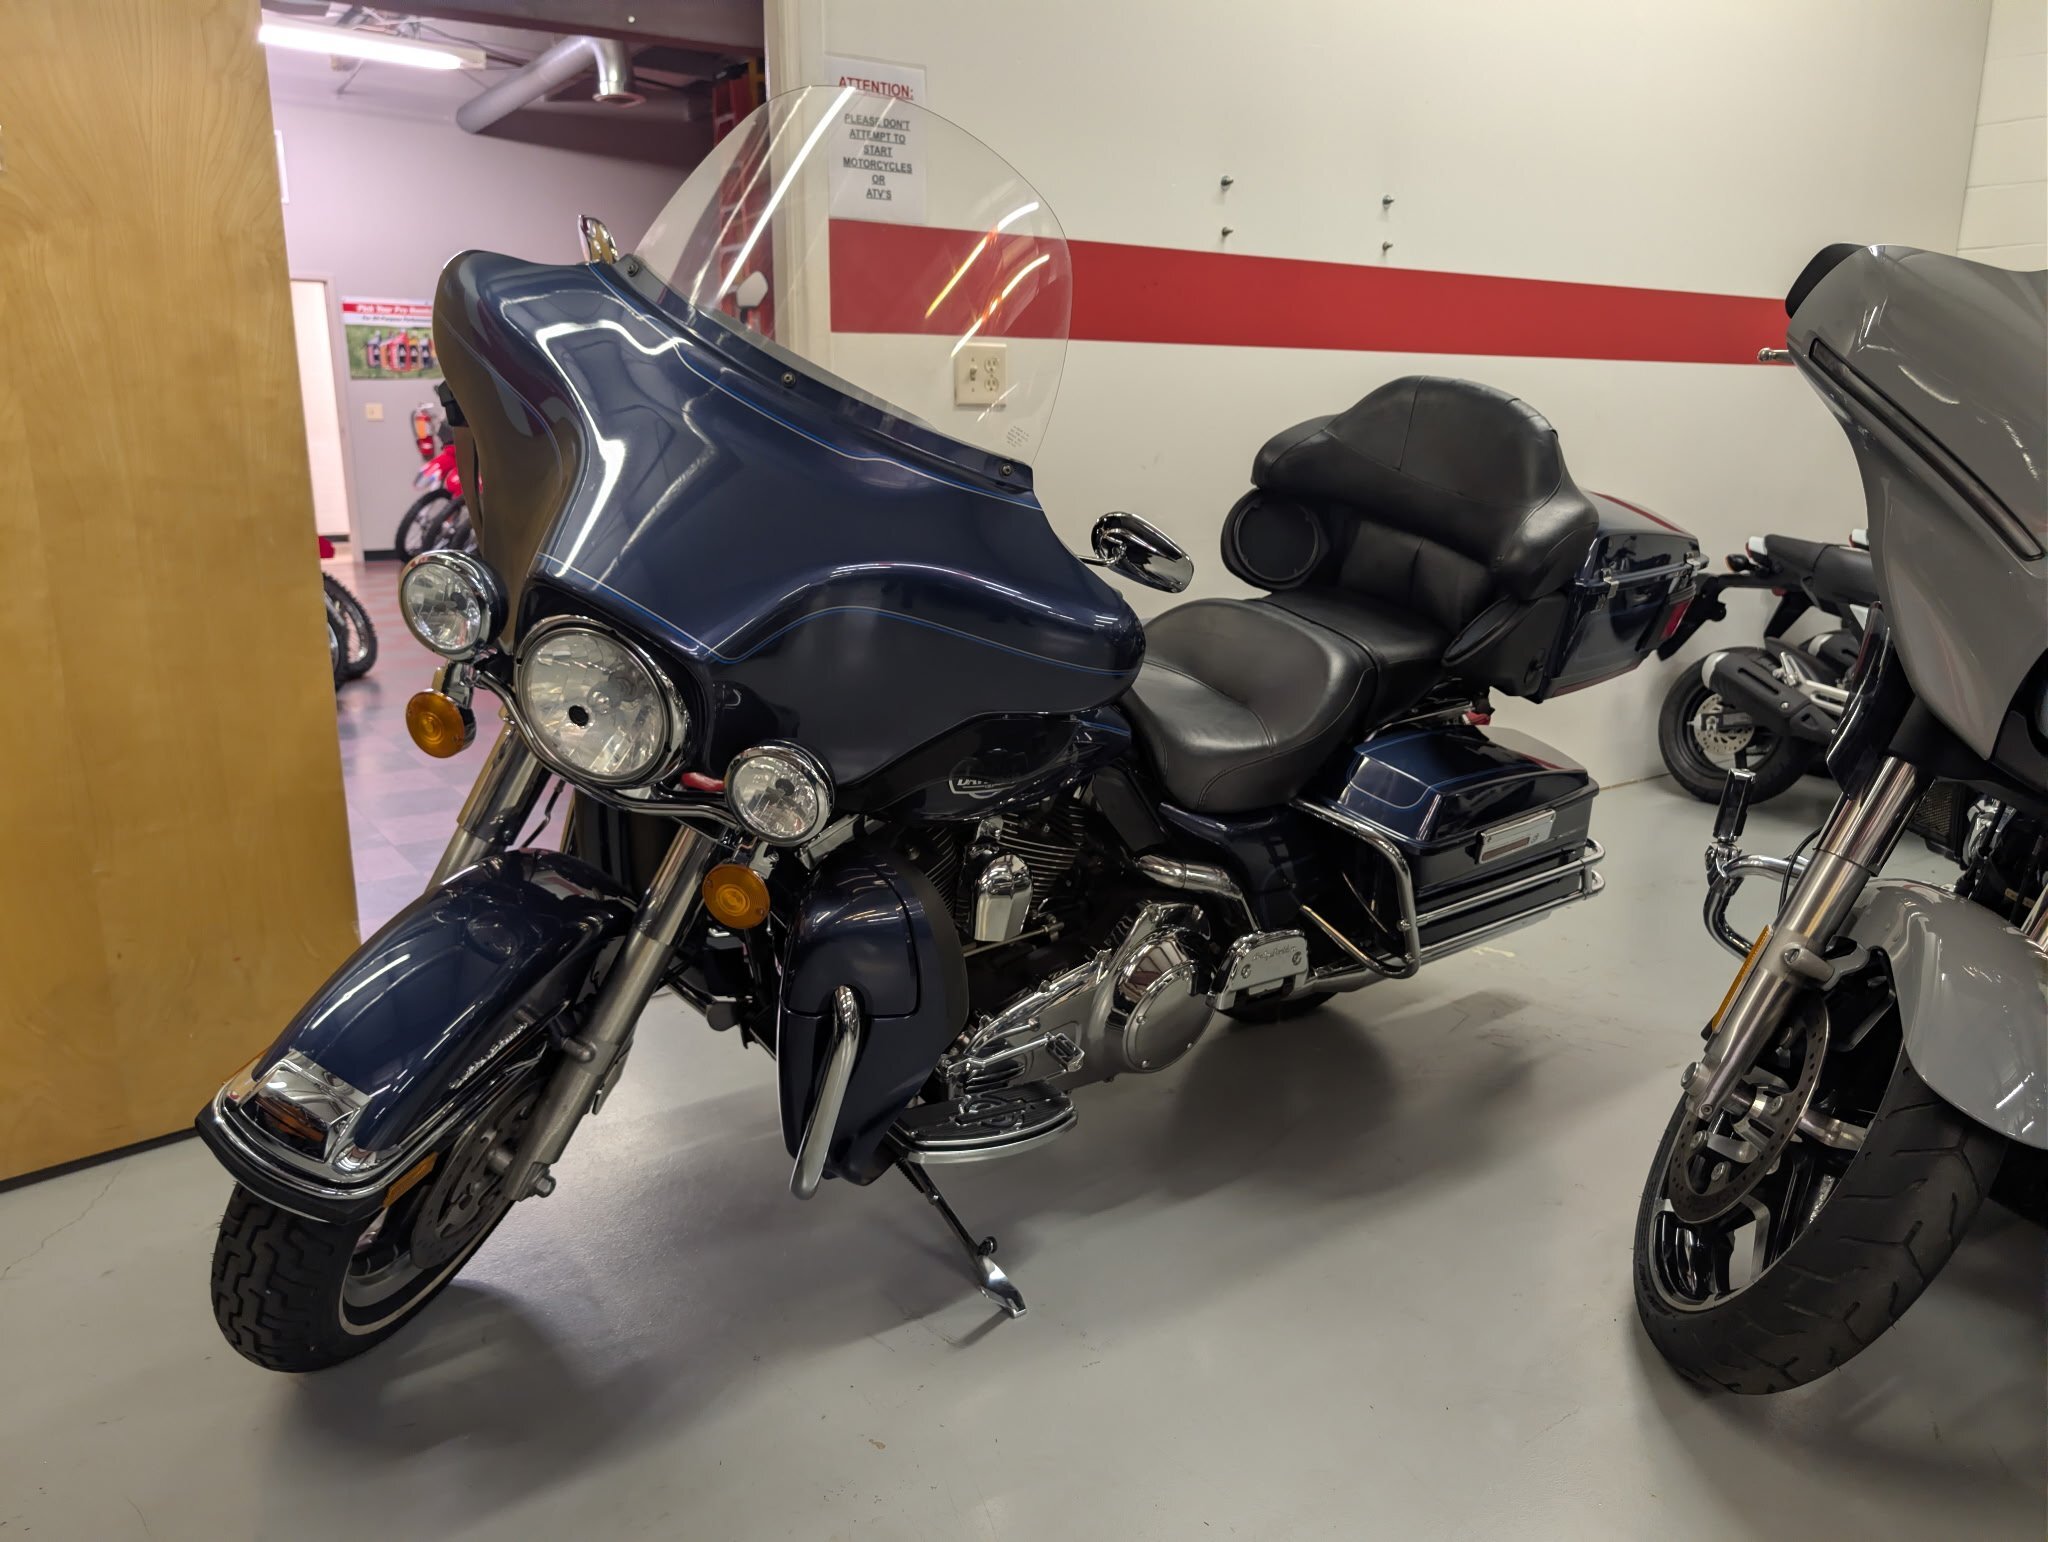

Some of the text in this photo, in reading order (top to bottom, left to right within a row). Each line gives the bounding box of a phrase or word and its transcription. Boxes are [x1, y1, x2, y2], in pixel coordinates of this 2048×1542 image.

[839, 76, 914, 99] ATTENTION:
[894, 134, 906, 145] TO
[863, 145, 892, 157] START
[843, 157, 912, 174] MOTORCYCLES
[872, 174, 886, 186] OR
[866, 188, 892, 200] ATV'S
